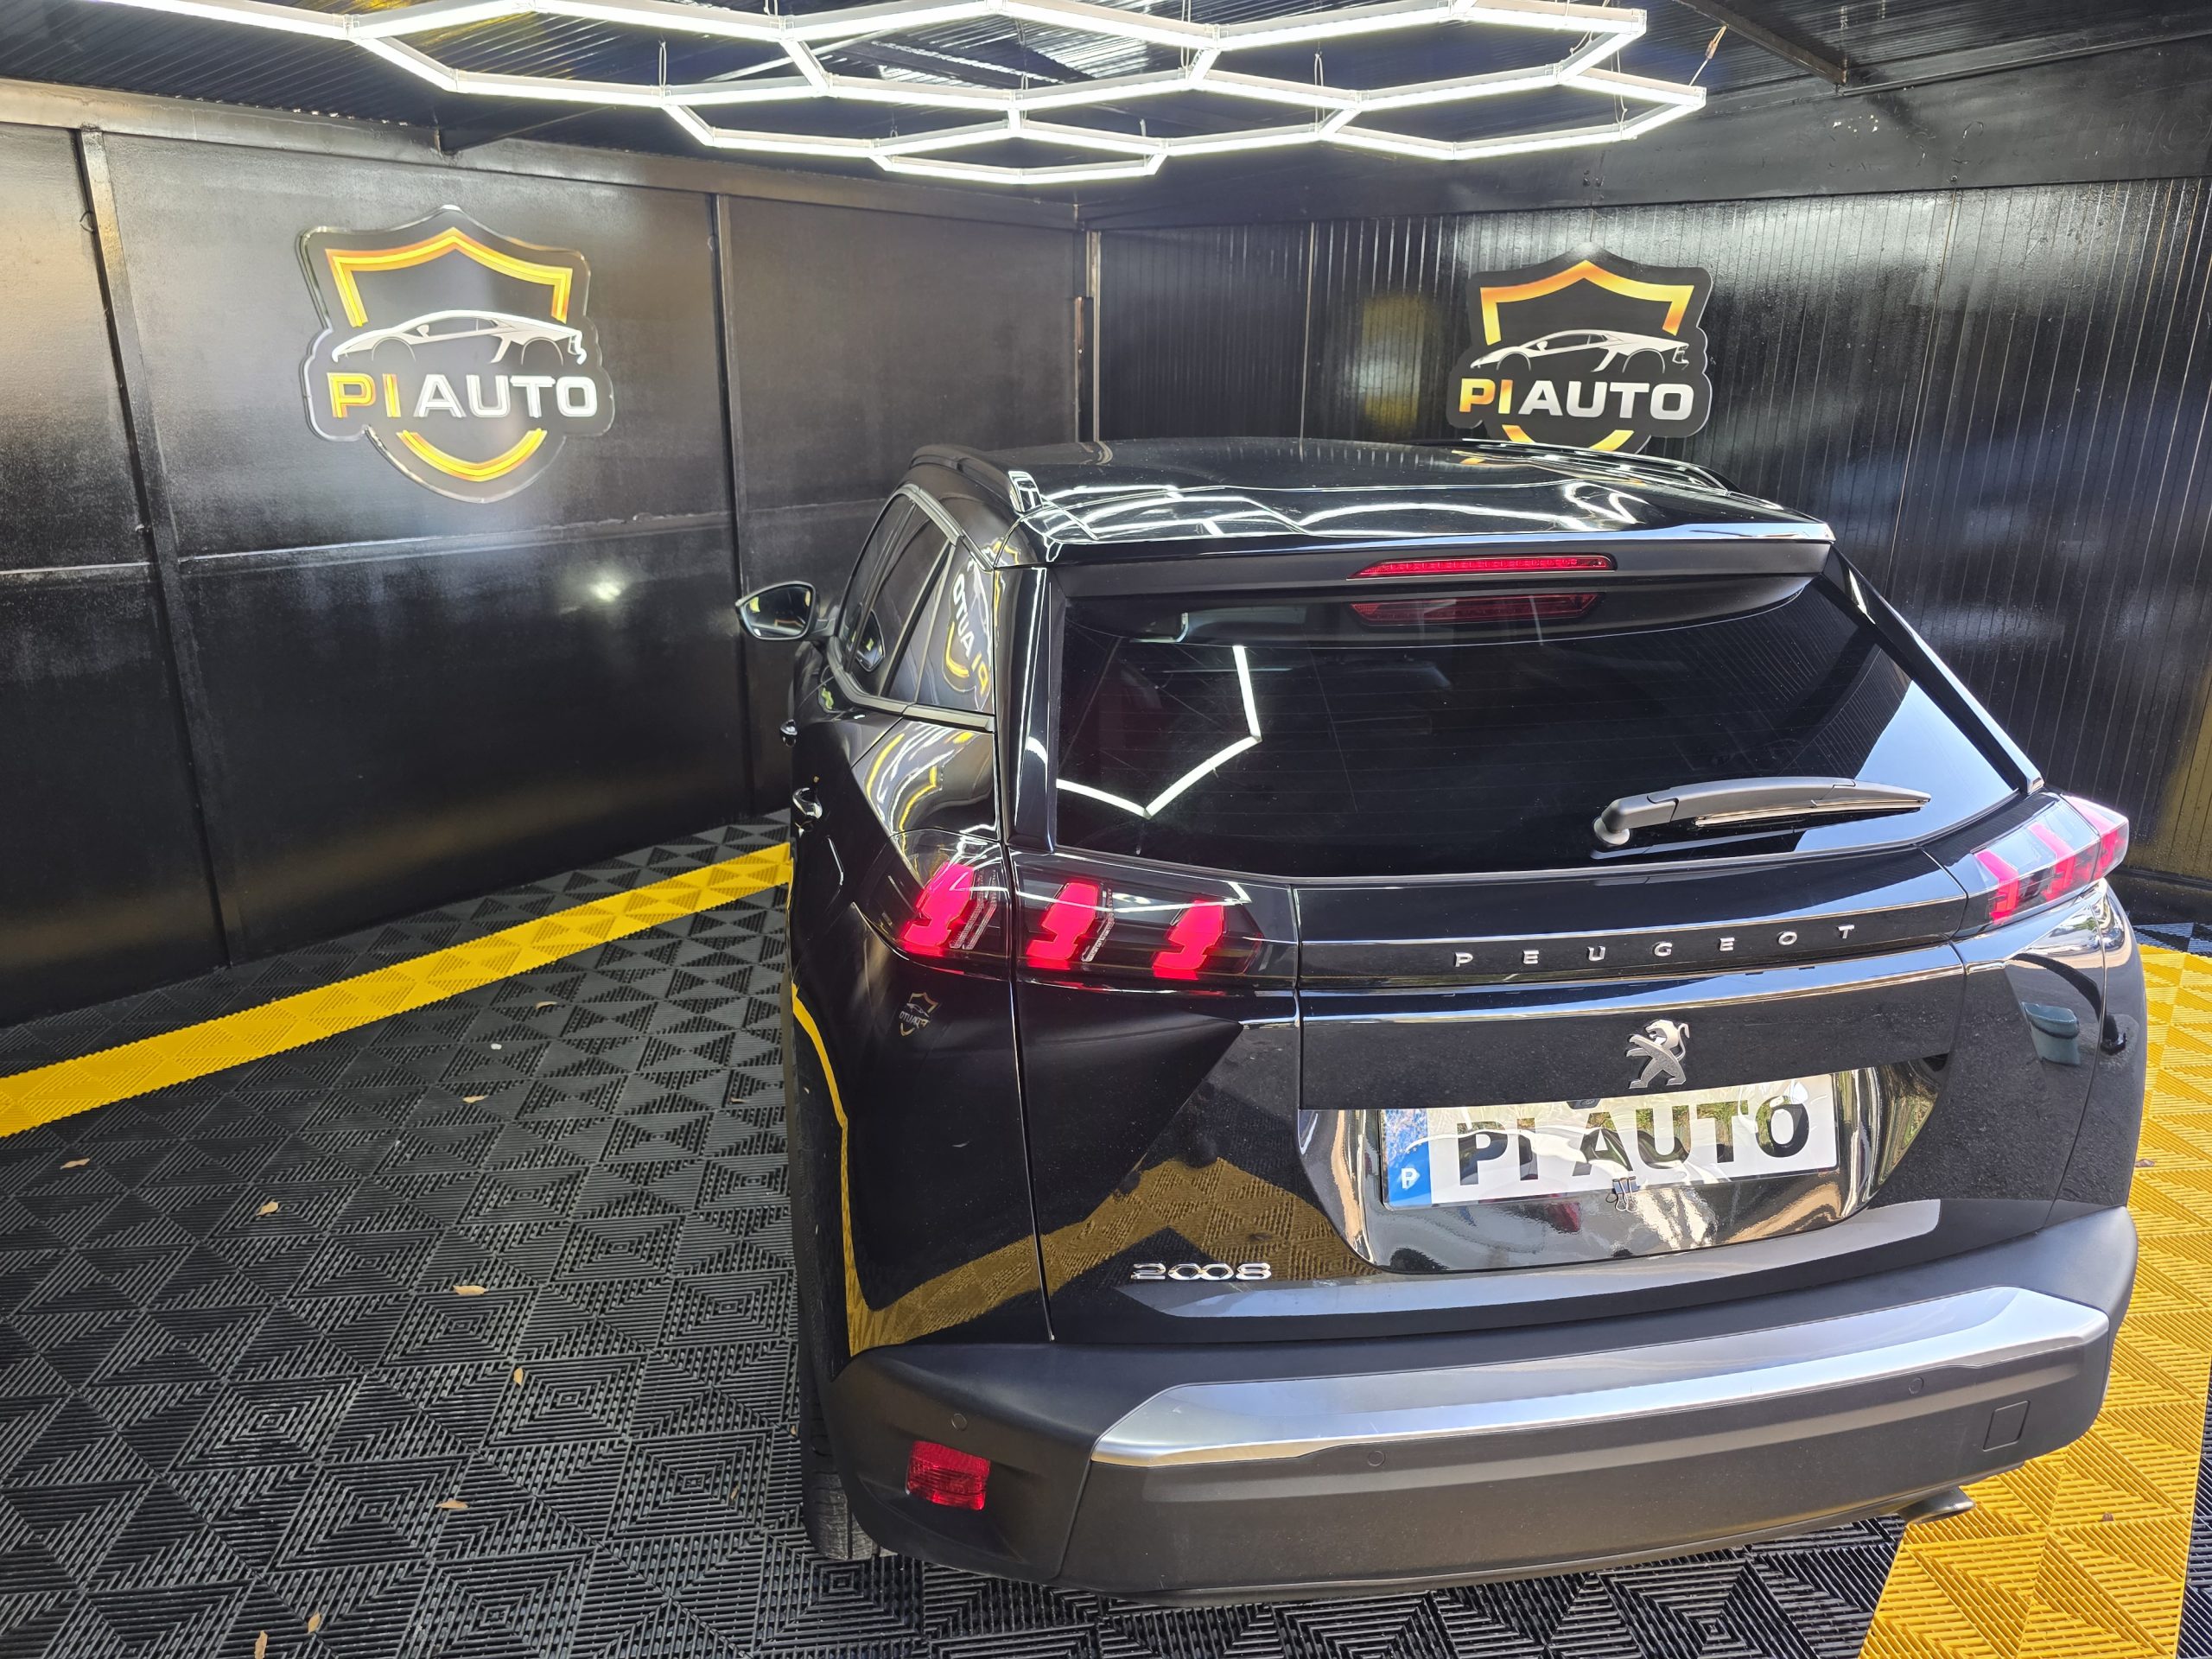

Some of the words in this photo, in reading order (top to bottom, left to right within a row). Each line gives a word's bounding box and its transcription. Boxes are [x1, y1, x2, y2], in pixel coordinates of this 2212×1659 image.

[327, 372, 401, 418] PI
[413, 373, 598, 419] AUTO
[1459, 378, 1514, 415] PI
[1517, 379, 1694, 421] AUTO
[1453, 924, 1856, 968] PEUGEOT
[1455, 1117, 1539, 1186] PI
[1571, 1093, 1810, 1177] AUTO
[1400, 1167, 1418, 1190] P
[1130, 1262, 1272, 1281] 2008
